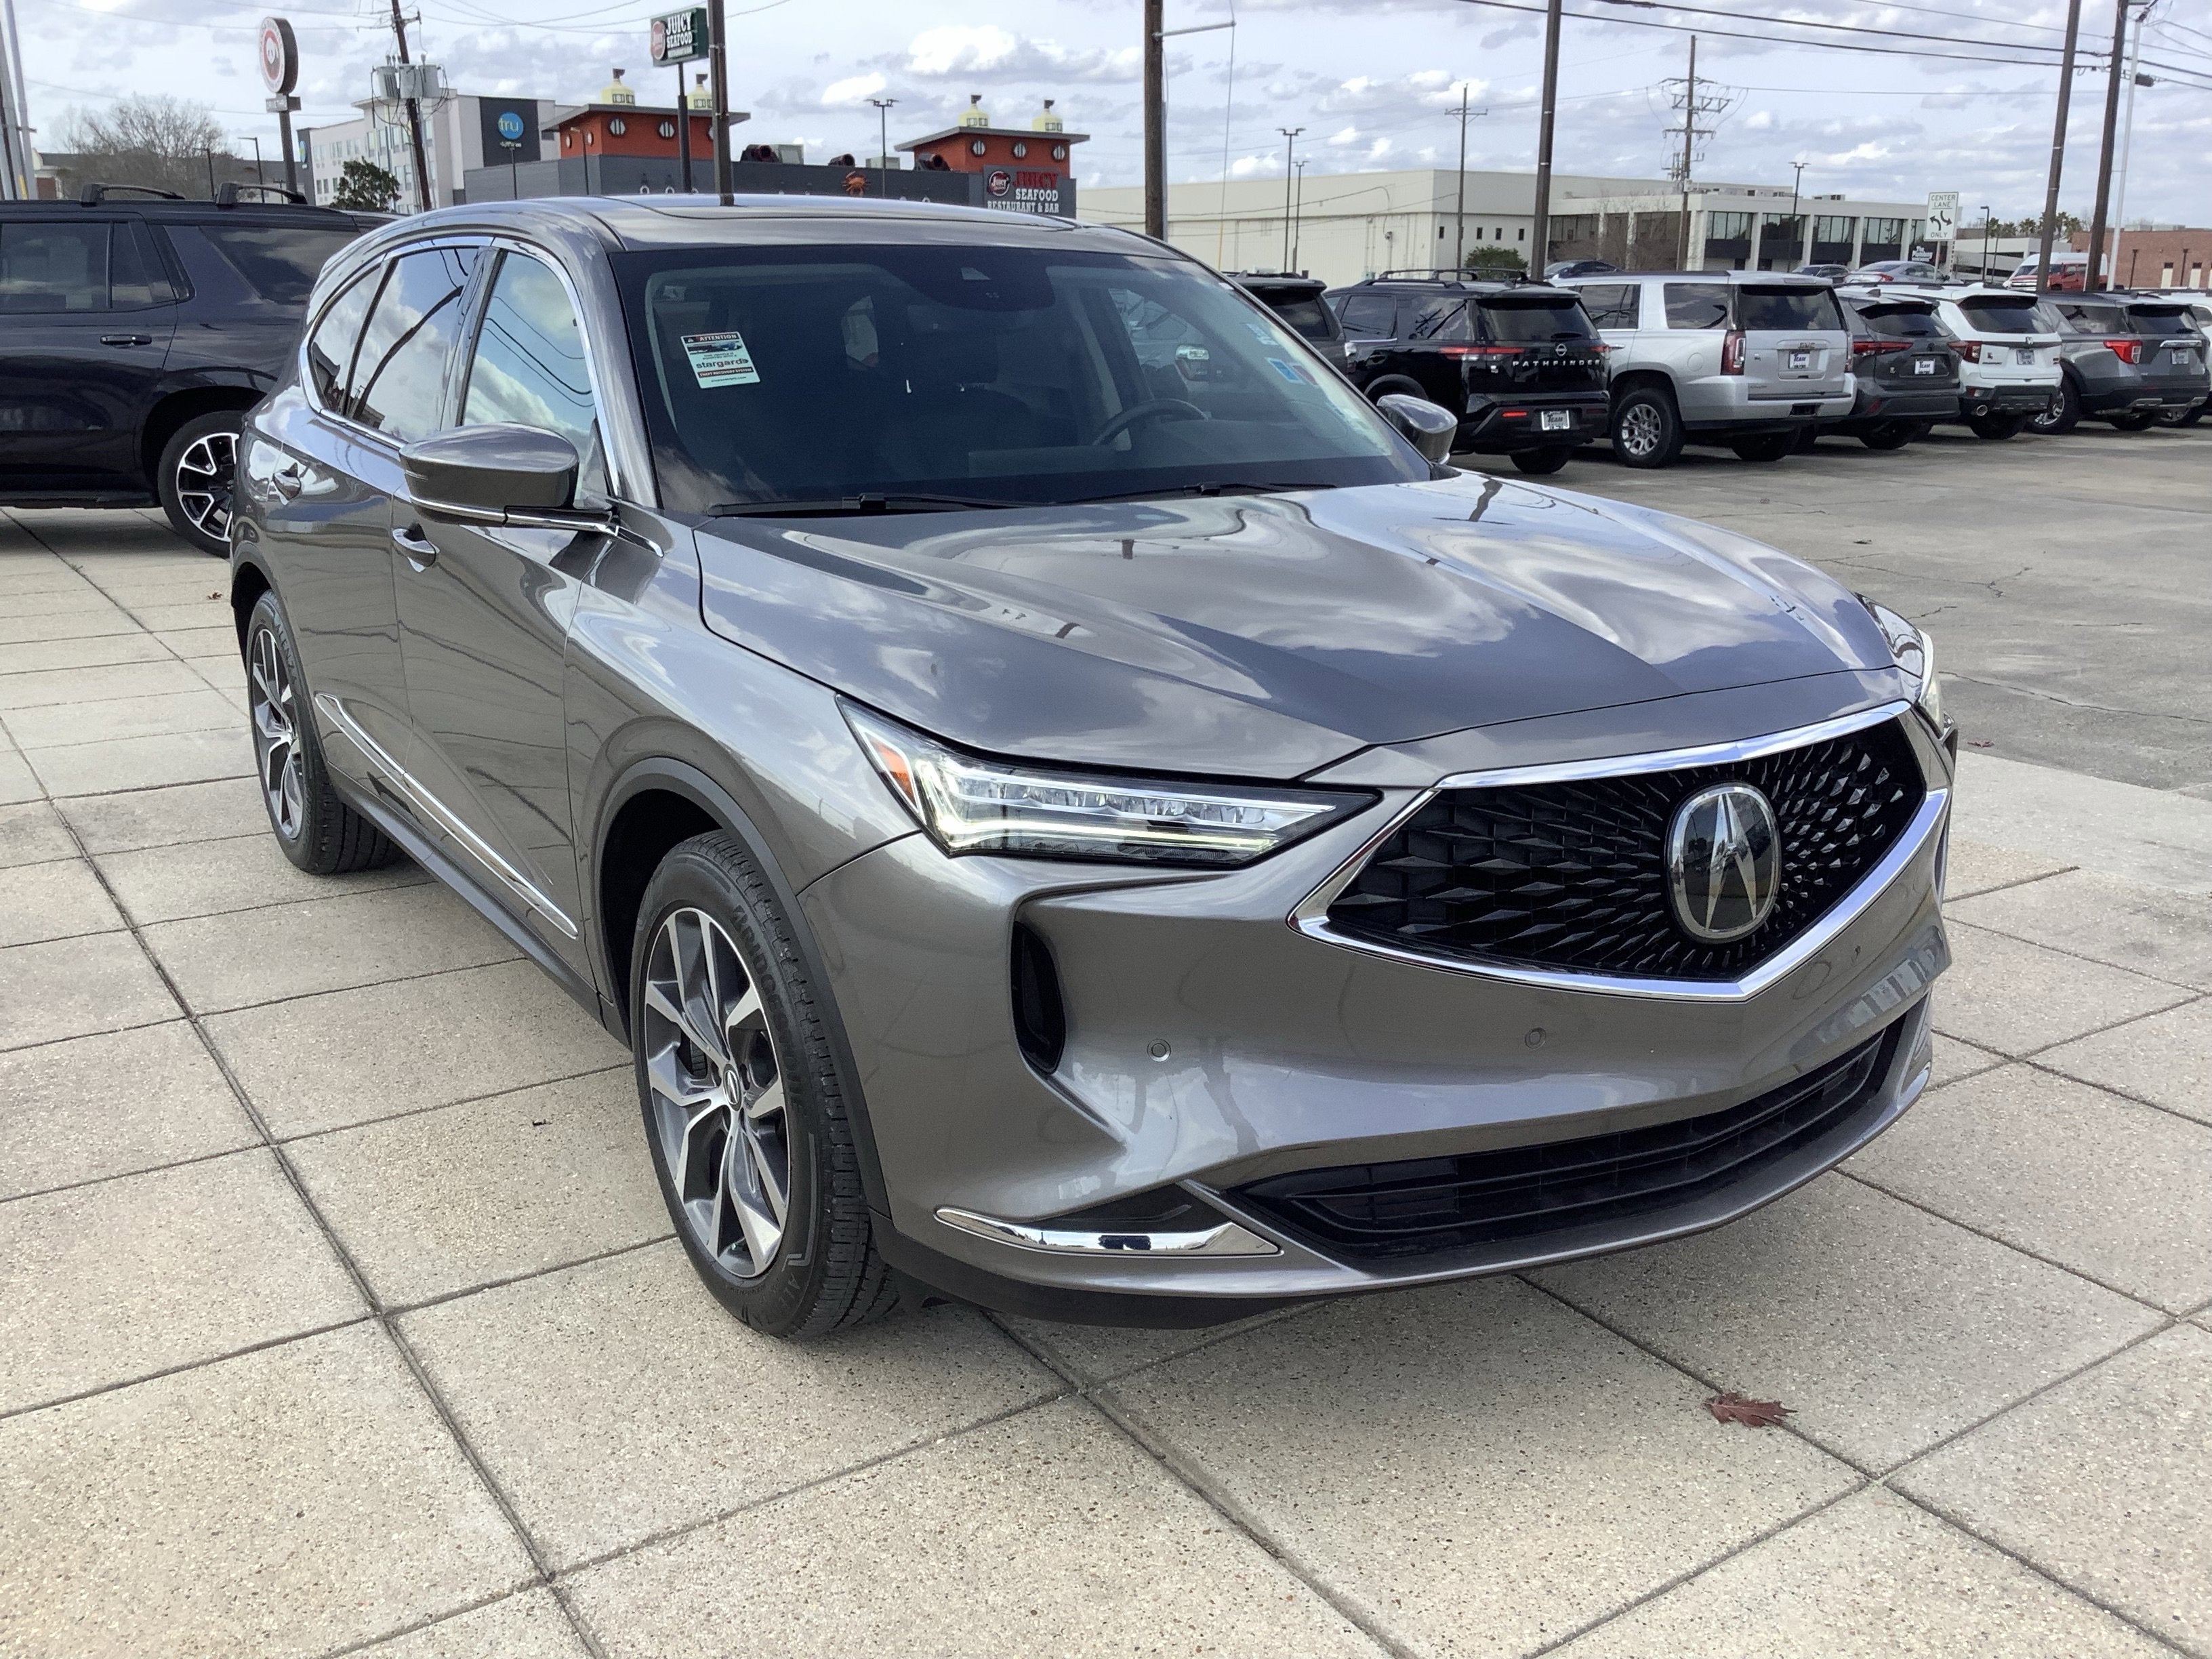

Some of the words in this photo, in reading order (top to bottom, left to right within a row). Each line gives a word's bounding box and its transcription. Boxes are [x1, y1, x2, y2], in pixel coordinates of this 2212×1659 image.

[665, 12, 691, 35] JUICY
[666, 31, 693, 48] SEAFOOD
[499, 118, 519, 132] tru
[1013, 171, 1058, 188] JUICY
[1015, 188, 1059, 201] SEAFOOD
[987, 201, 1036, 212] RESTAURANT
[1038, 203, 1043, 212] &
[1044, 203, 1059, 213] BAR
